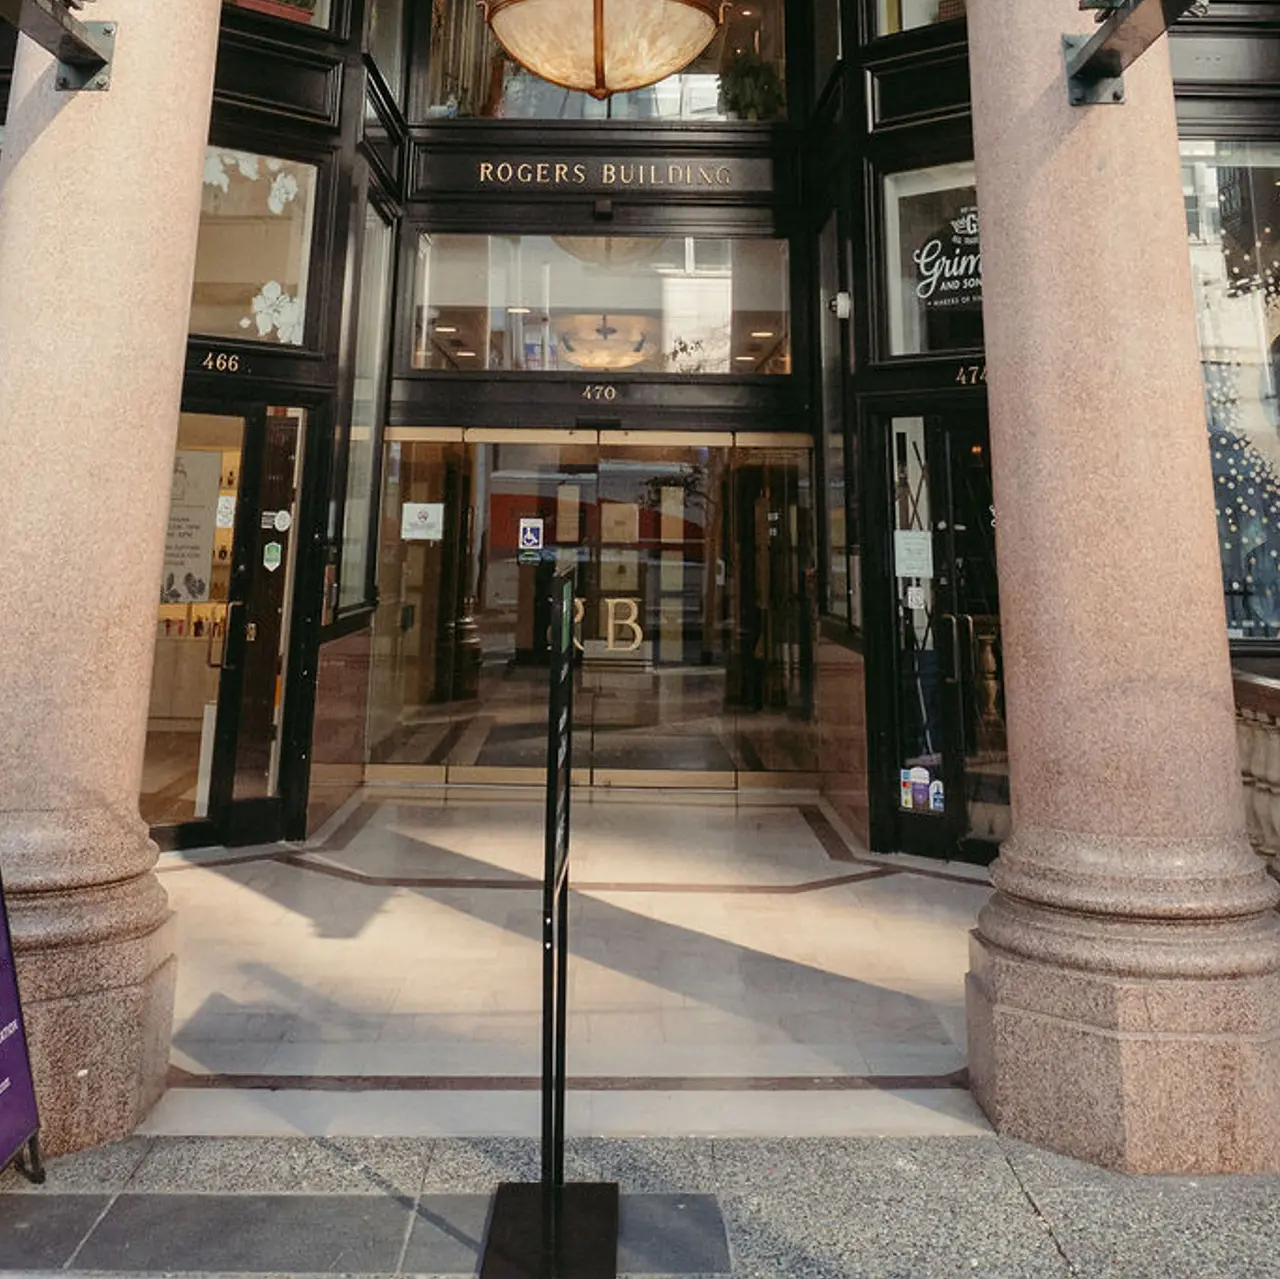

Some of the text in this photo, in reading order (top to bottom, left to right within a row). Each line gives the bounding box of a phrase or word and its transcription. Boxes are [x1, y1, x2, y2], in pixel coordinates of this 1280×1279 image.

[479, 162, 732, 186] ROGERS BUILDING
[940, 280, 960, 291] AND
[202, 351, 239, 372] 466
[582, 383, 617, 401] 470
